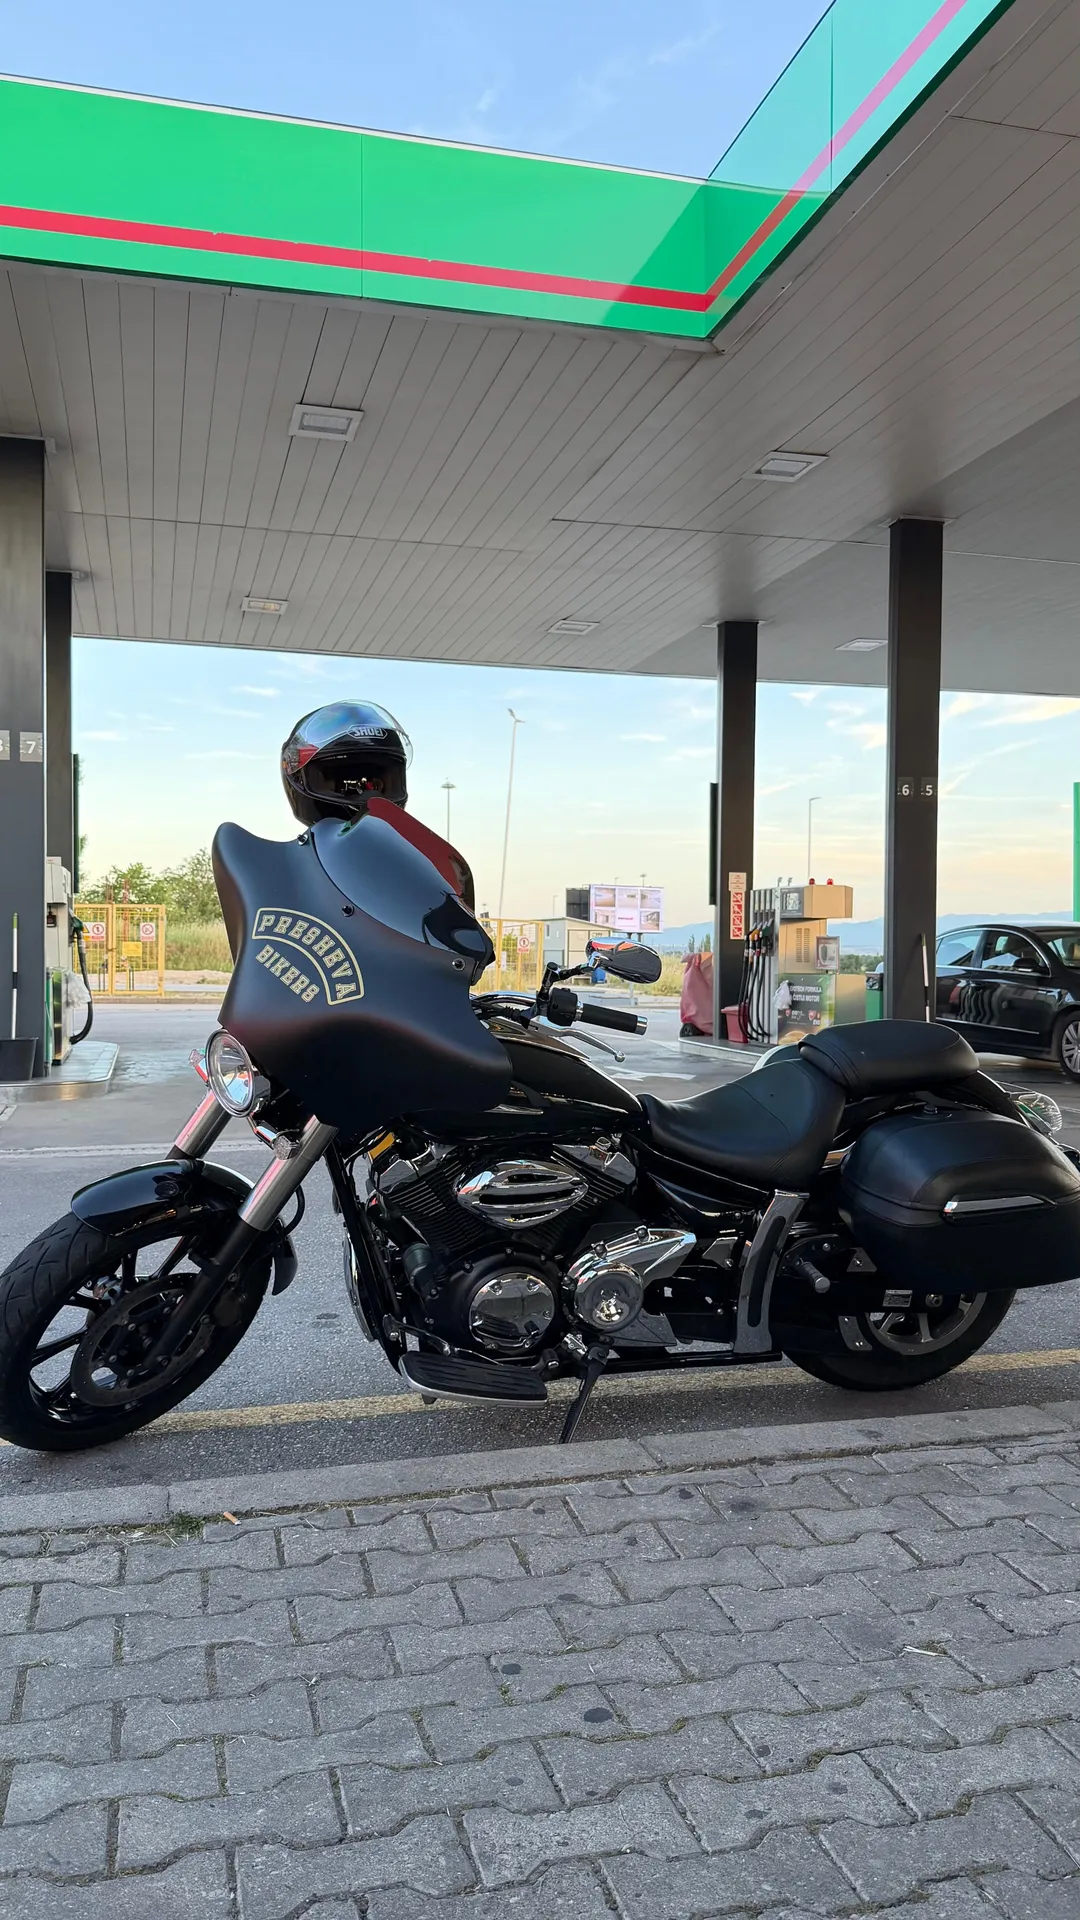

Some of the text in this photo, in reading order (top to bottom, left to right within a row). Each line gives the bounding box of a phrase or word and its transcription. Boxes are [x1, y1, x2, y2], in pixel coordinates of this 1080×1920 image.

[353, 726, 384, 737] SHOEI
[26, 740, 36, 754] 7
[902, 784, 910, 796] 6
[925, 784, 933, 796] 5
[257, 914, 357, 1000] PRESHEVA
[255, 944, 320, 1003] BIKERS
